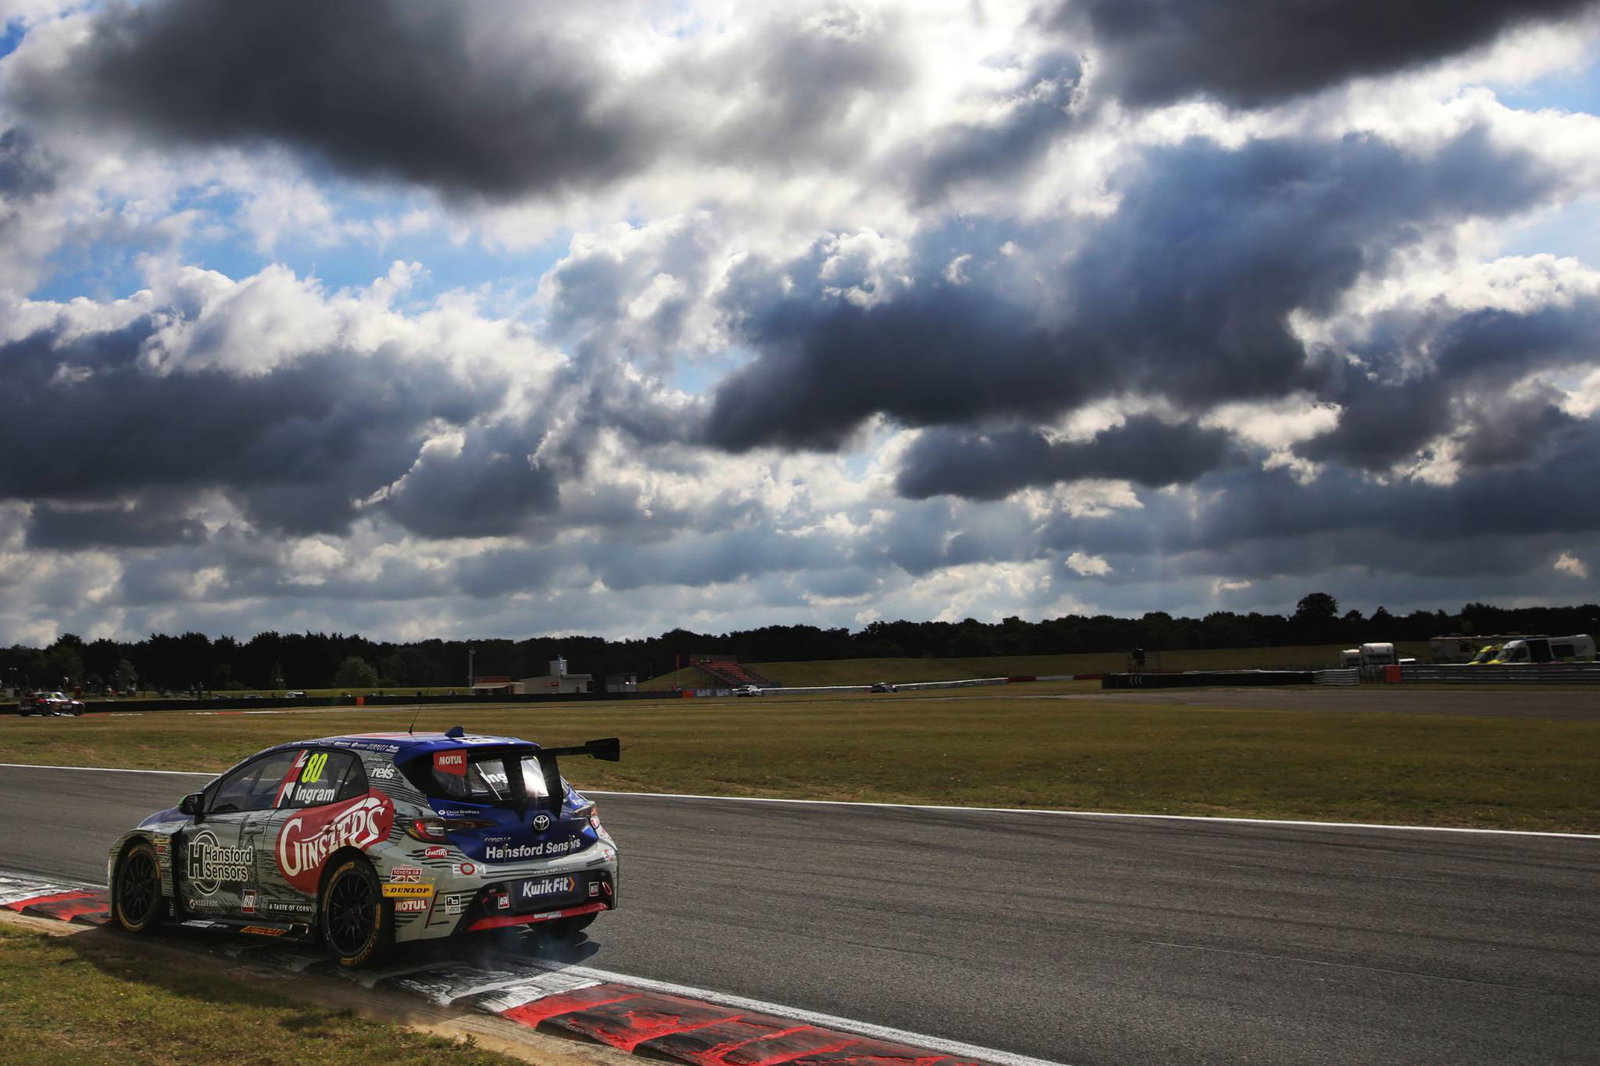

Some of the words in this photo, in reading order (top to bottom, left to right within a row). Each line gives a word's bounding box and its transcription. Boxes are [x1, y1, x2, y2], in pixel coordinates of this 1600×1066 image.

[301, 753, 328, 783] 80
[438, 755, 462, 766] MOTUL
[371, 763, 395, 779] reis
[481, 773, 509, 784] Ing
[295, 784, 335, 804] Ingram
[205, 845, 252, 865] Hansford
[486, 843, 543, 859] Hansford
[205, 862, 248, 881] Sensors
[395, 901, 427, 911] MOTUL
